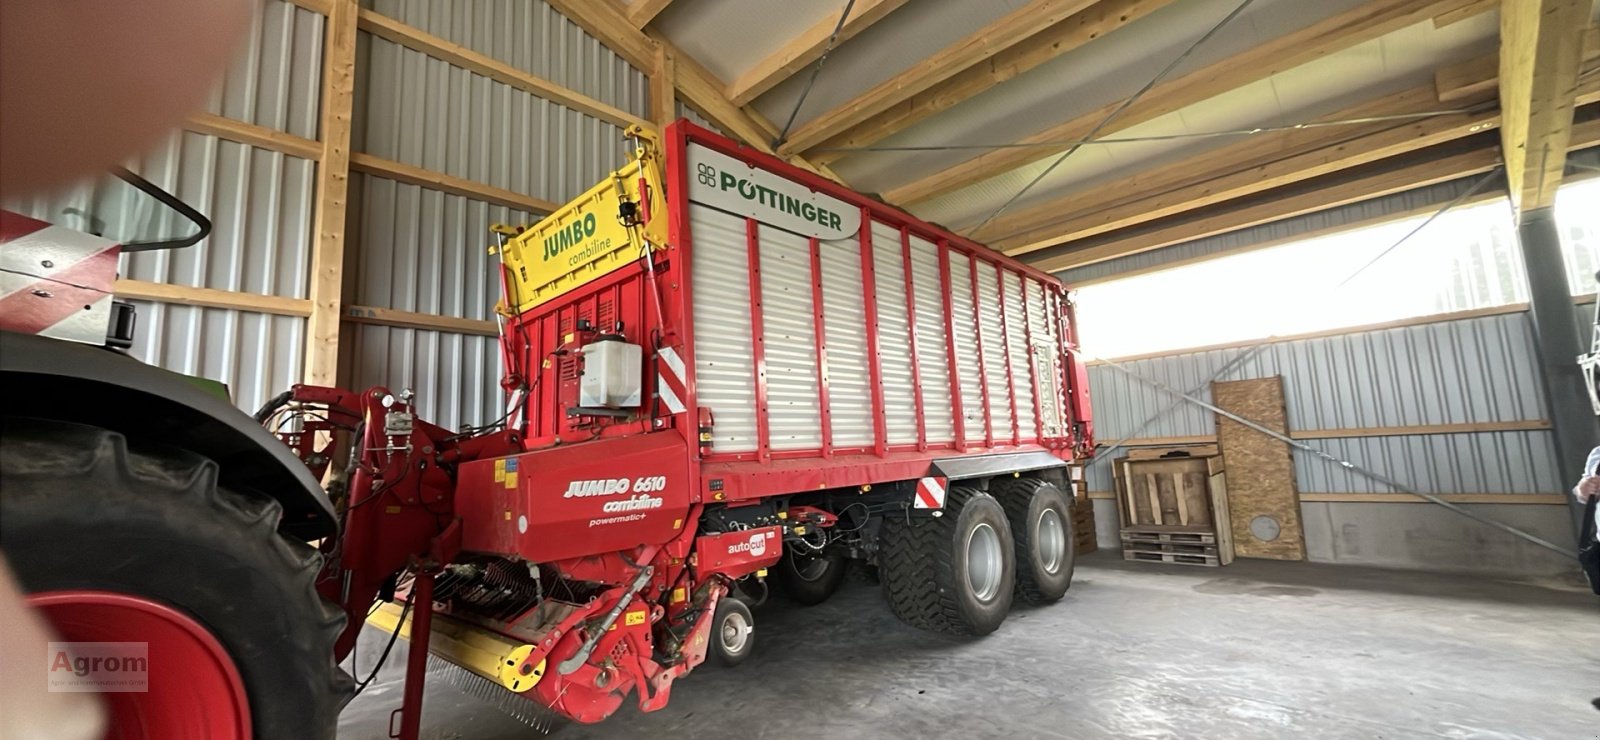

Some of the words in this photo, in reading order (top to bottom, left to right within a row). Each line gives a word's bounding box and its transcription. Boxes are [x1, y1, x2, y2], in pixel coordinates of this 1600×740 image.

[544, 212, 596, 261] JUMBO
[568, 238, 611, 266] combiline
[563, 478, 631, 498] JUMBO
[633, 476, 666, 492] 6610
[603, 494, 663, 513] combiline
[589, 513, 647, 527] powermatic+
